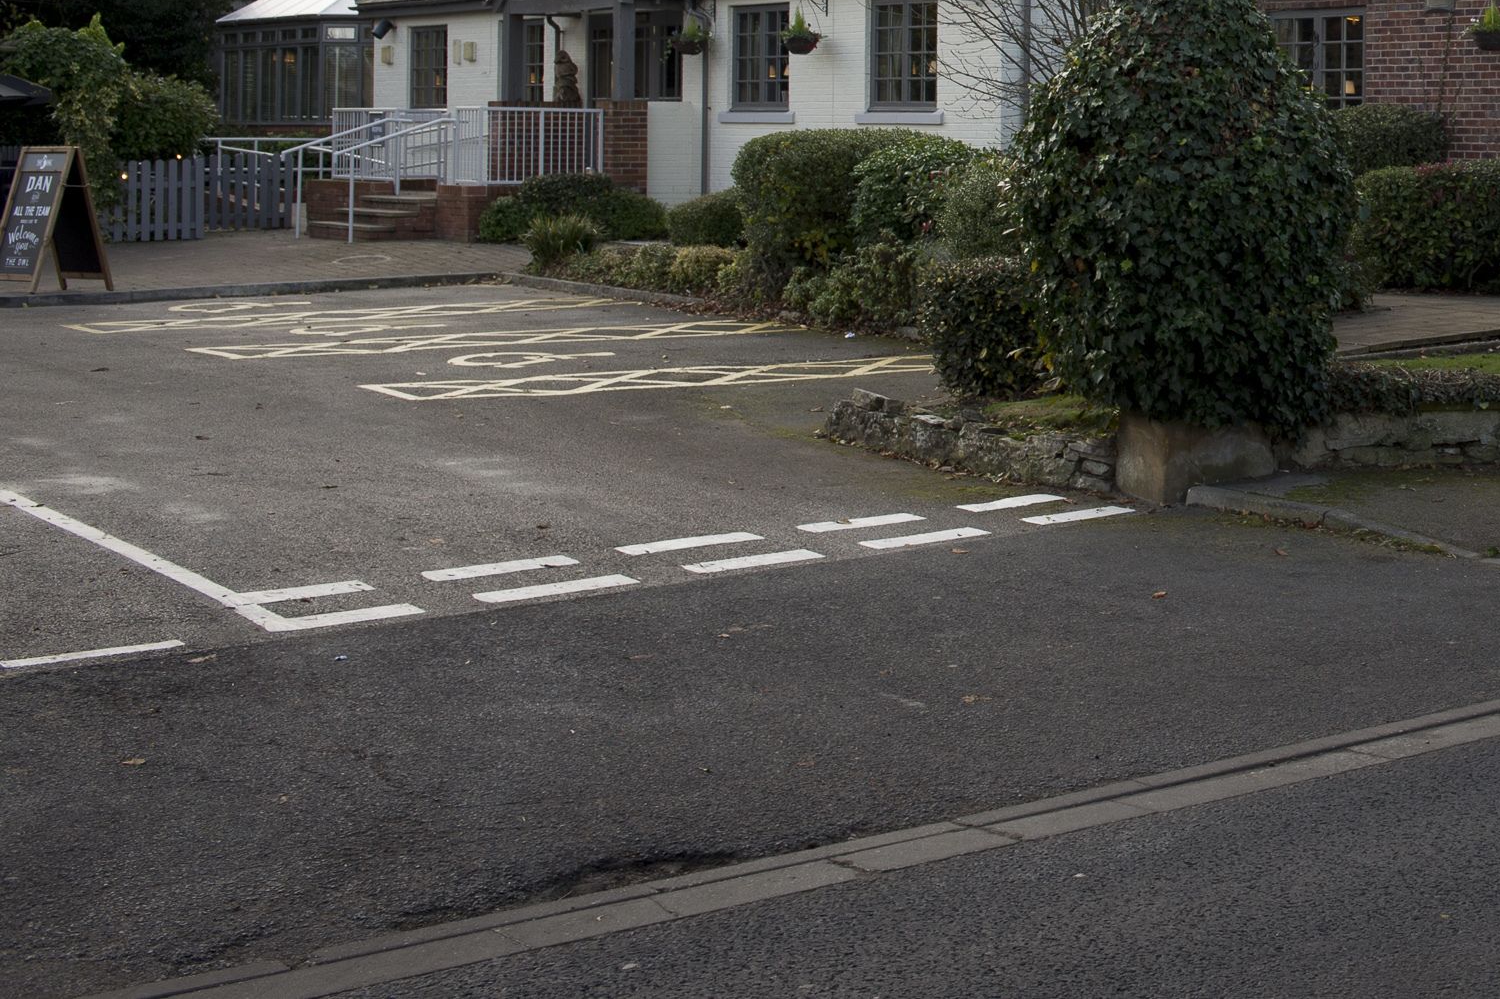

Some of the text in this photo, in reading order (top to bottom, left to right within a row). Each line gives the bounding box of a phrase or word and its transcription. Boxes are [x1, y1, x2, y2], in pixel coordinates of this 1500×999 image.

[25, 175, 53, 193] DAN
[13, 205, 51, 216] ALL THE TEAM
[8, 224, 39, 245] Welcome
[5, 257, 29, 266] THE OWL
